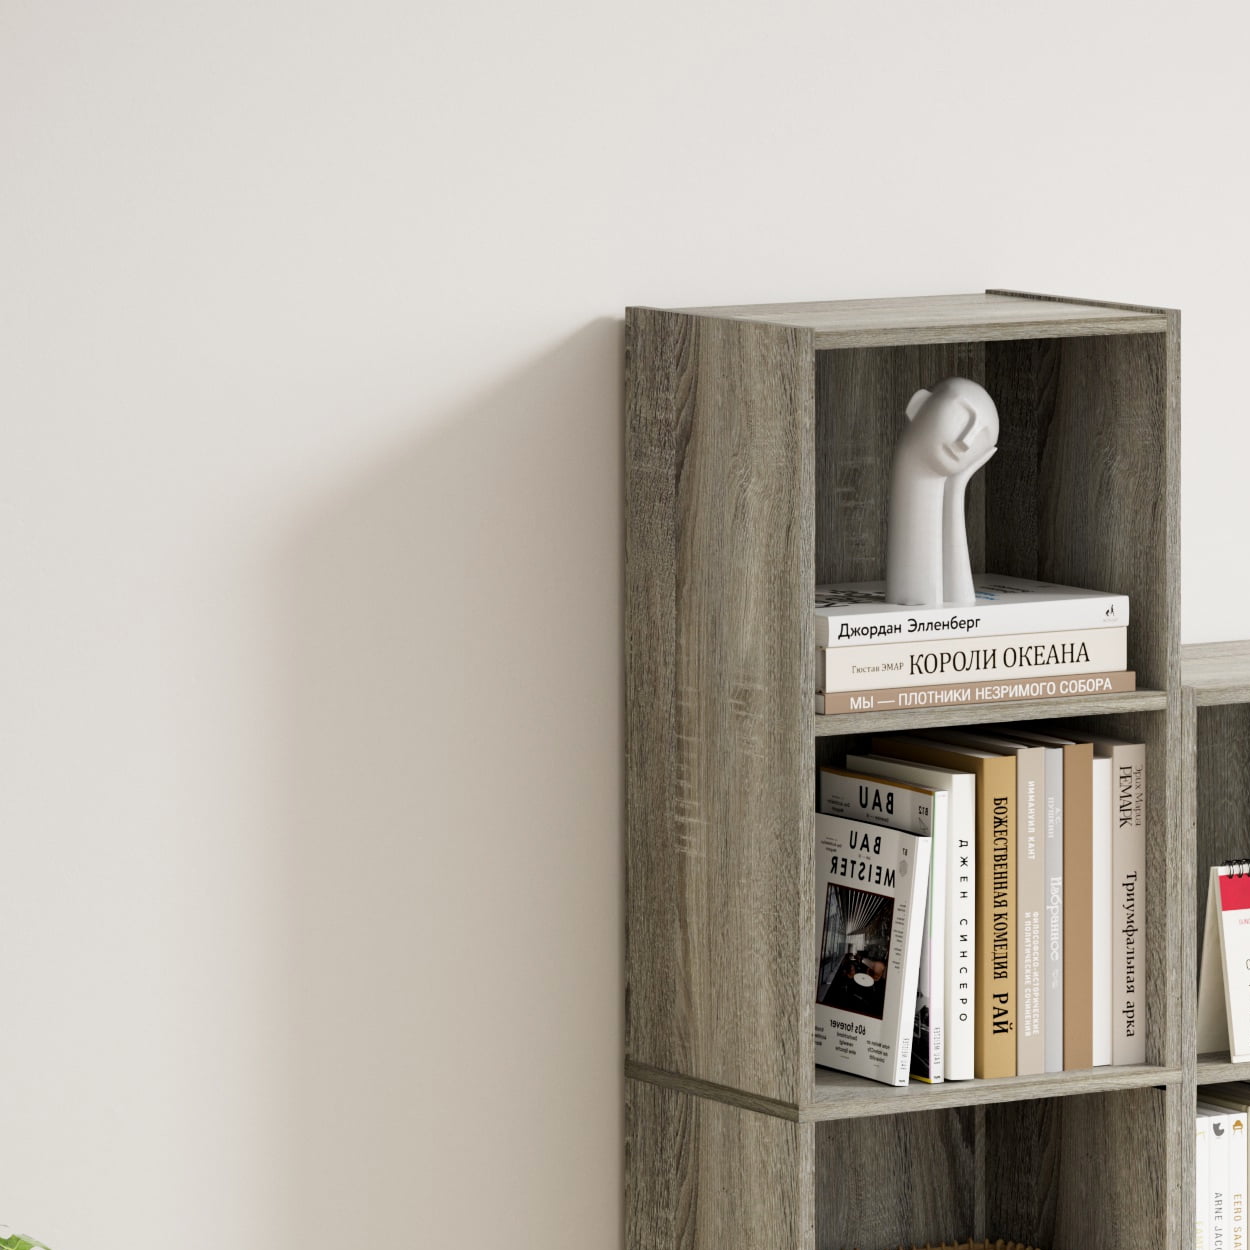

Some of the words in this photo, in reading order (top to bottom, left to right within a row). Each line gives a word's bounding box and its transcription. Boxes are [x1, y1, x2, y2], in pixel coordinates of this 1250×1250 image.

[838, 621, 902, 640] Джордан
[907, 617, 980, 633] Элленберг
[908, 649, 997, 675] КОРОЛИ
[1003, 642, 1090, 668] ОКЕАНА
[850, 697, 874, 710] МЫ
[898, 689, 971, 707] ПЛОТНИКИ
[975, 681, 1056, 700] НЕЗРИМОГО
[1059, 677, 1112, 694] СОБОРА
[1027, 780, 1035, 833] ИММАНУИЛ
[1119, 766, 1132, 829] РЕМАРК
[959, 839, 969, 899] ДЖЕН
[993, 797, 1008, 909] БОЖЕСТВЕННАЯ
[1027, 836, 1036, 860] КАНТ
[993, 912, 1008, 980] КОМЕДИЯ
[1121, 871, 1138, 994] Триумфальная
[959, 918, 968, 1022] СИНСЕРО
[992, 992, 1013, 1035] РАЙ
[1122, 1000, 1134, 1038] арка
[1214, 1192, 1223, 1221] ARNE
[1233, 1193, 1242, 1222] EERO
